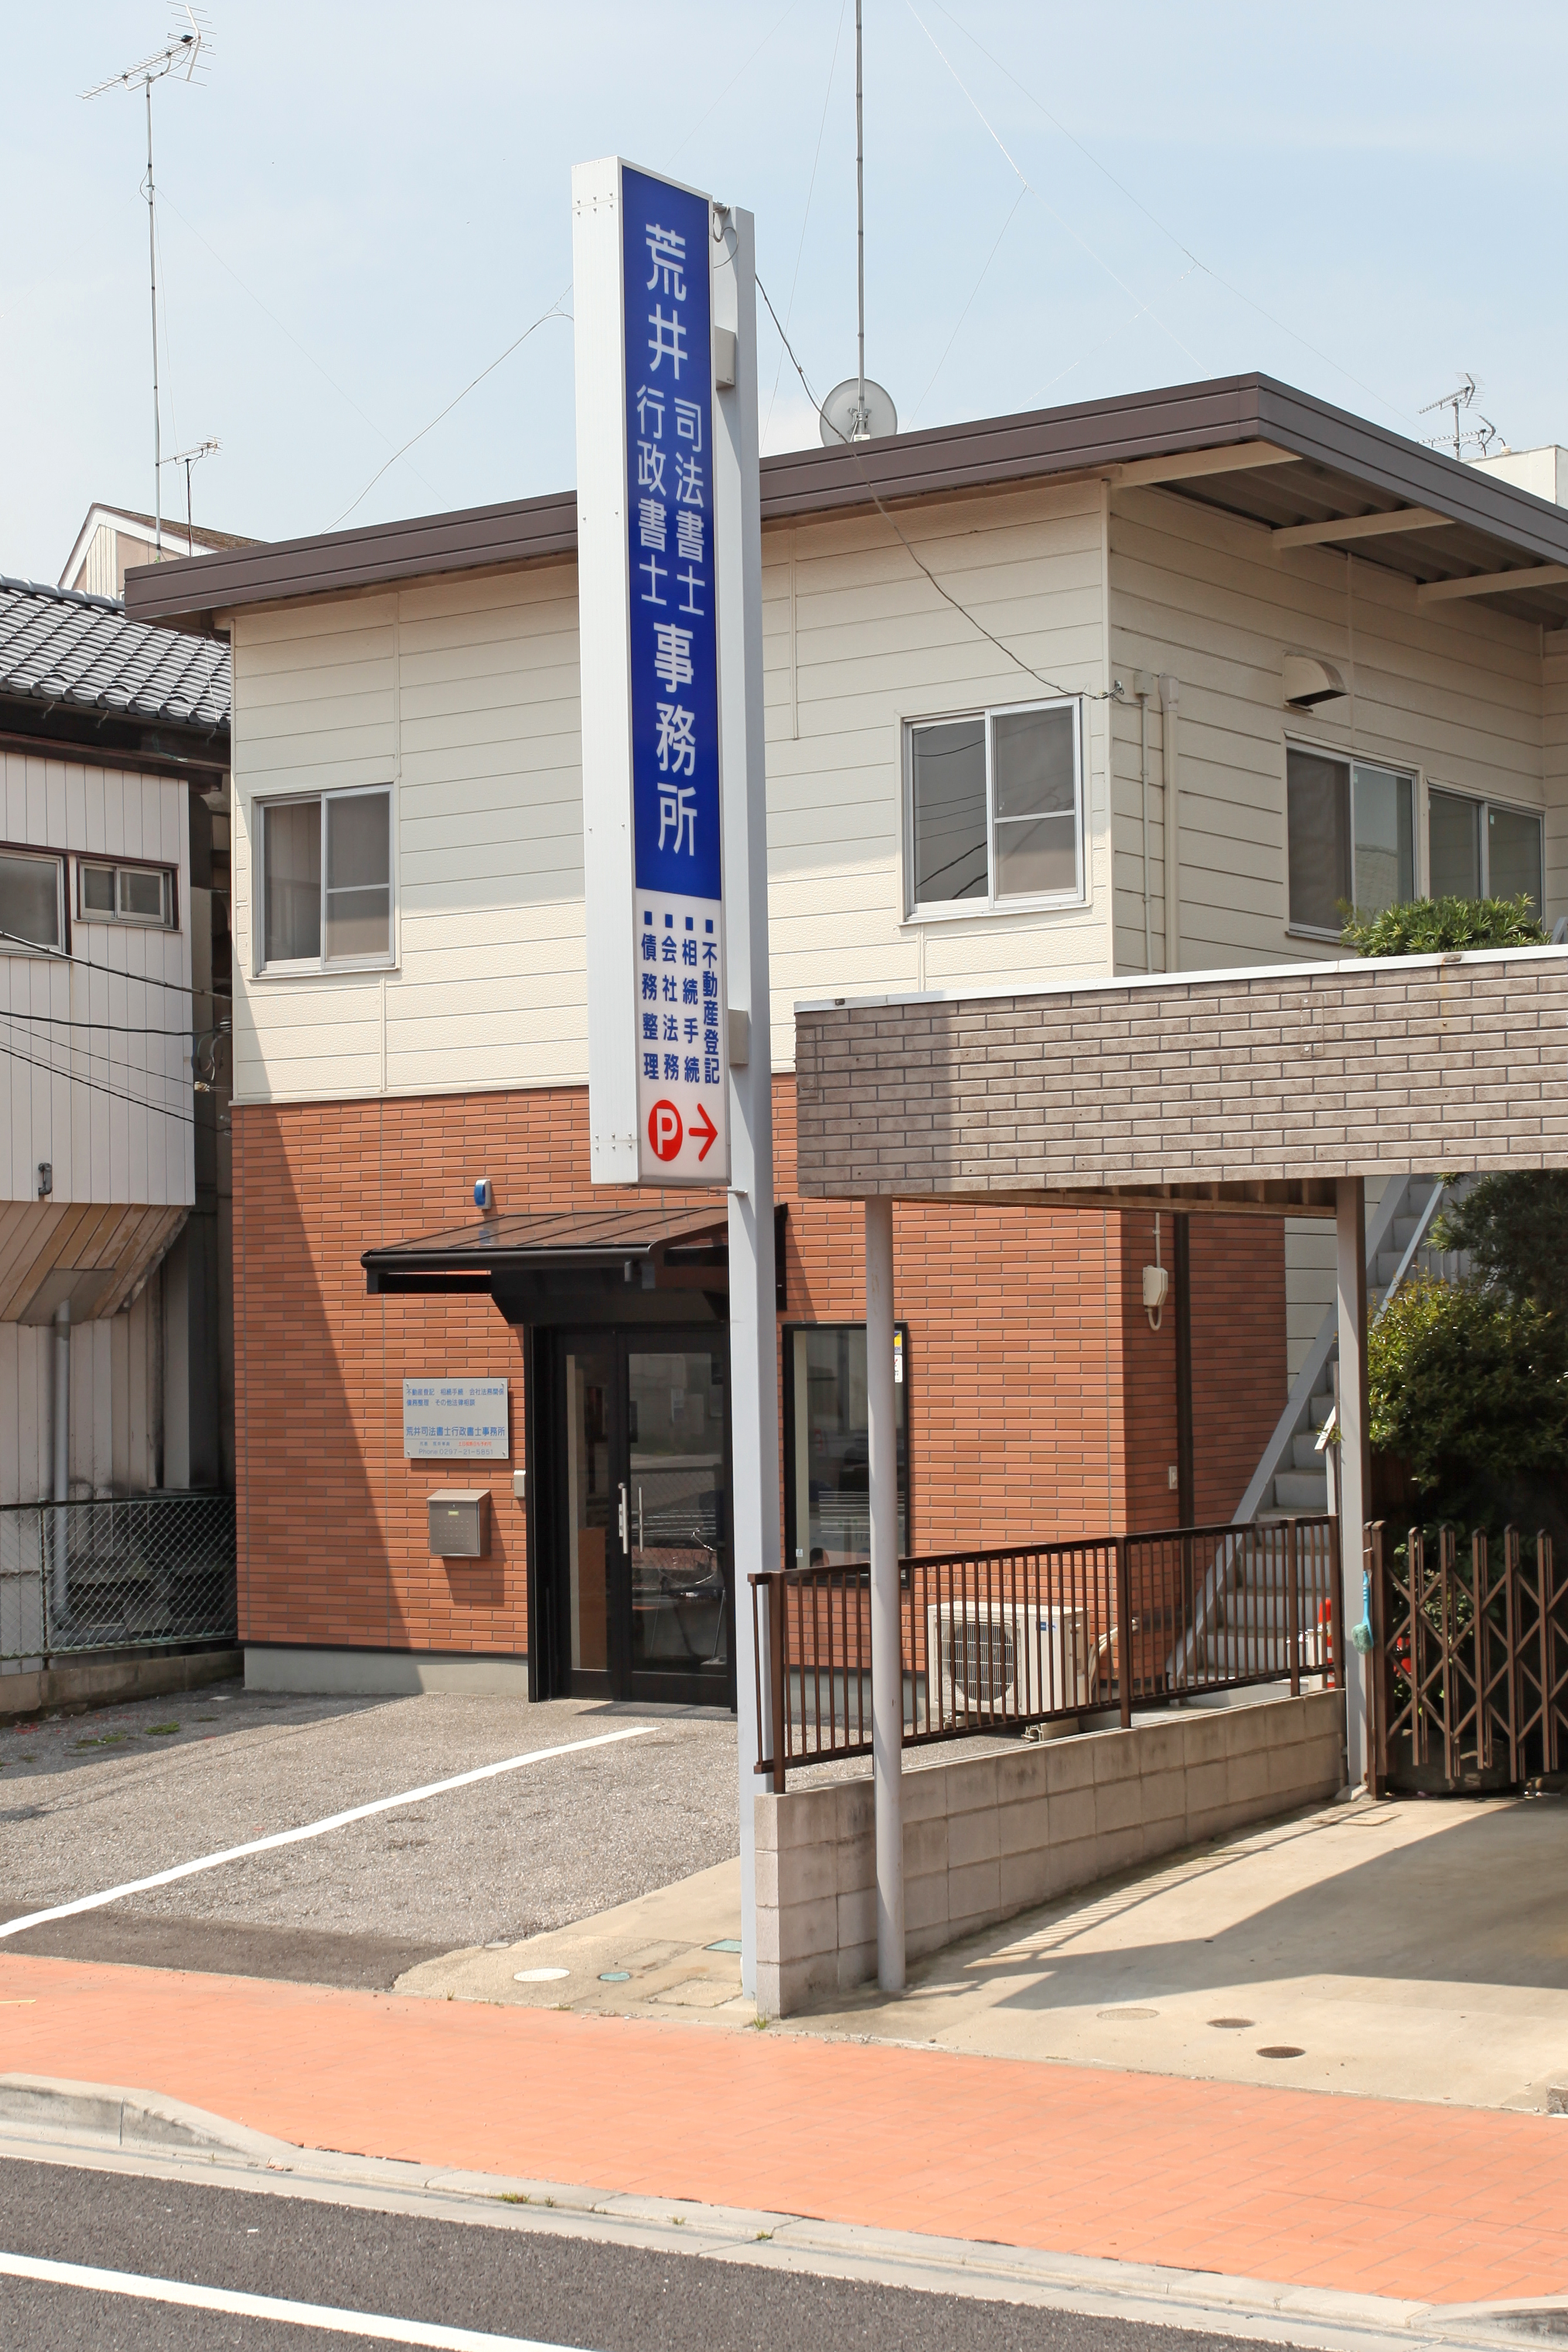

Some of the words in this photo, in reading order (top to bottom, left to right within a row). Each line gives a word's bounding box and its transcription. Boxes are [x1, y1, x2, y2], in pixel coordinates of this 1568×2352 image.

[644, 223, 688, 381] 荒井
[636, 384, 668, 606] 行政書士
[673, 397, 706, 616] 司法書士
[653, 622, 697, 856] 事務所
[641, 933, 660, 1080] 債務整理
[662, 935, 679, 1082] 会社法務
[682, 939, 700, 1083] 相続手続
[702, 941, 720, 1085] 不動産登記
[656, 1107, 678, 1155] P
[406, 1426, 505, 1436] 荒井司法書士行政書士事務所
